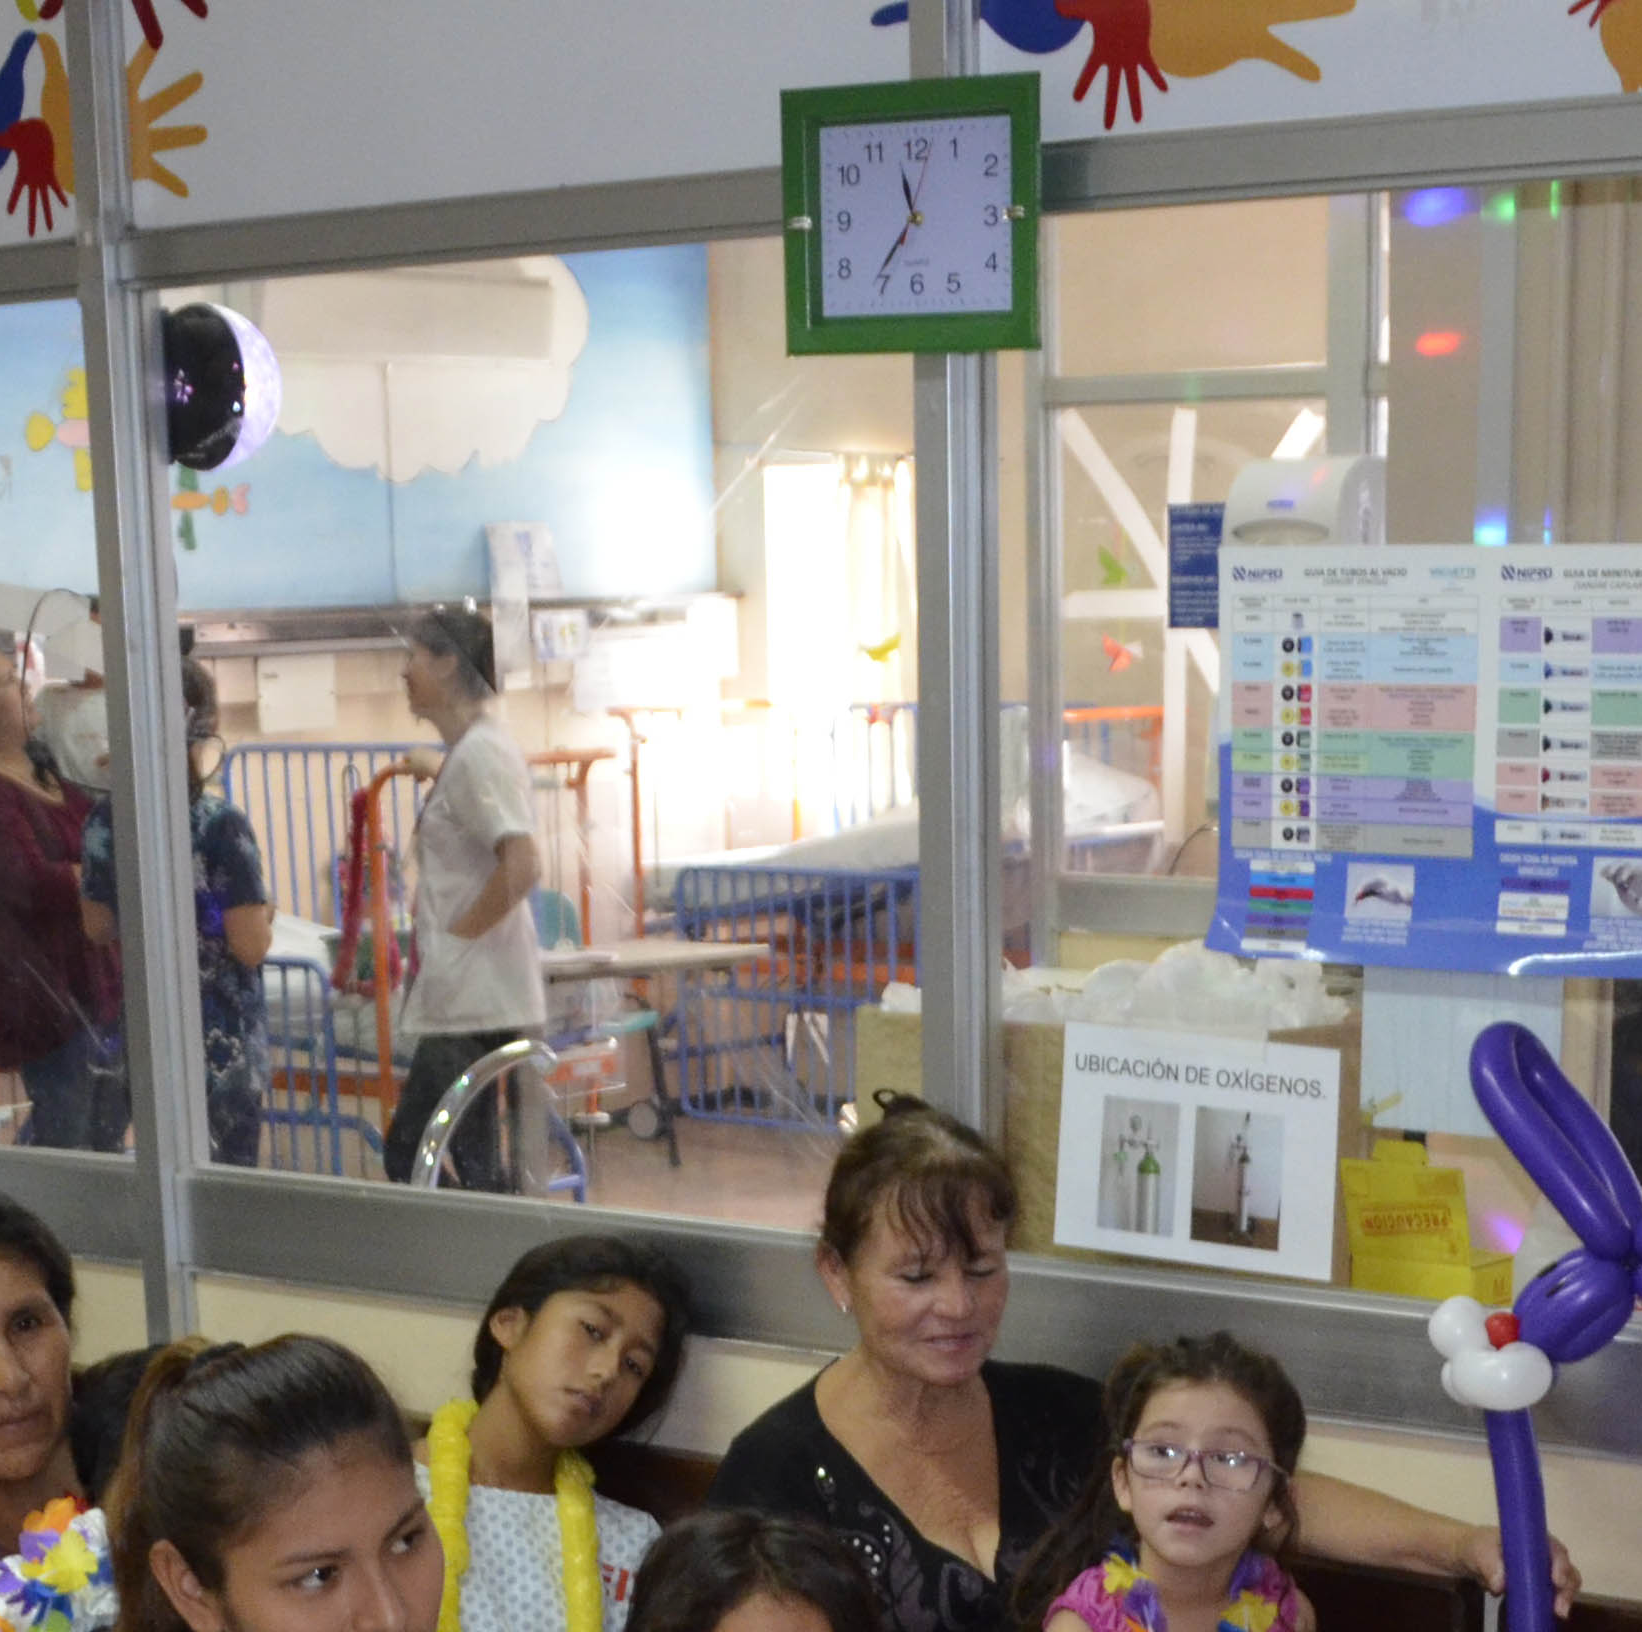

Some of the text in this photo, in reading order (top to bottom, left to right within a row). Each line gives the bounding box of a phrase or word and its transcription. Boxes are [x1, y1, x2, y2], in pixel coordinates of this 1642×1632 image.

[864, 143, 885, 164] 11
[903, 138, 929, 162] 12
[949, 136, 960, 159] 1
[837, 164, 861, 186] 10
[983, 153, 999, 178] 2
[837, 210, 852, 233] 9
[983, 204, 999, 227] 3
[837, 257, 852, 280] 8
[984, 251, 998, 273] 4
[877, 273, 891, 296] 7
[910, 272, 925, 295] 6
[946, 271, 961, 294] 5
[1517, 567, 1553, 581] NIPRO
[1074, 1053, 1328, 1100] UBICACIÓN DE OXÍGENOS.
